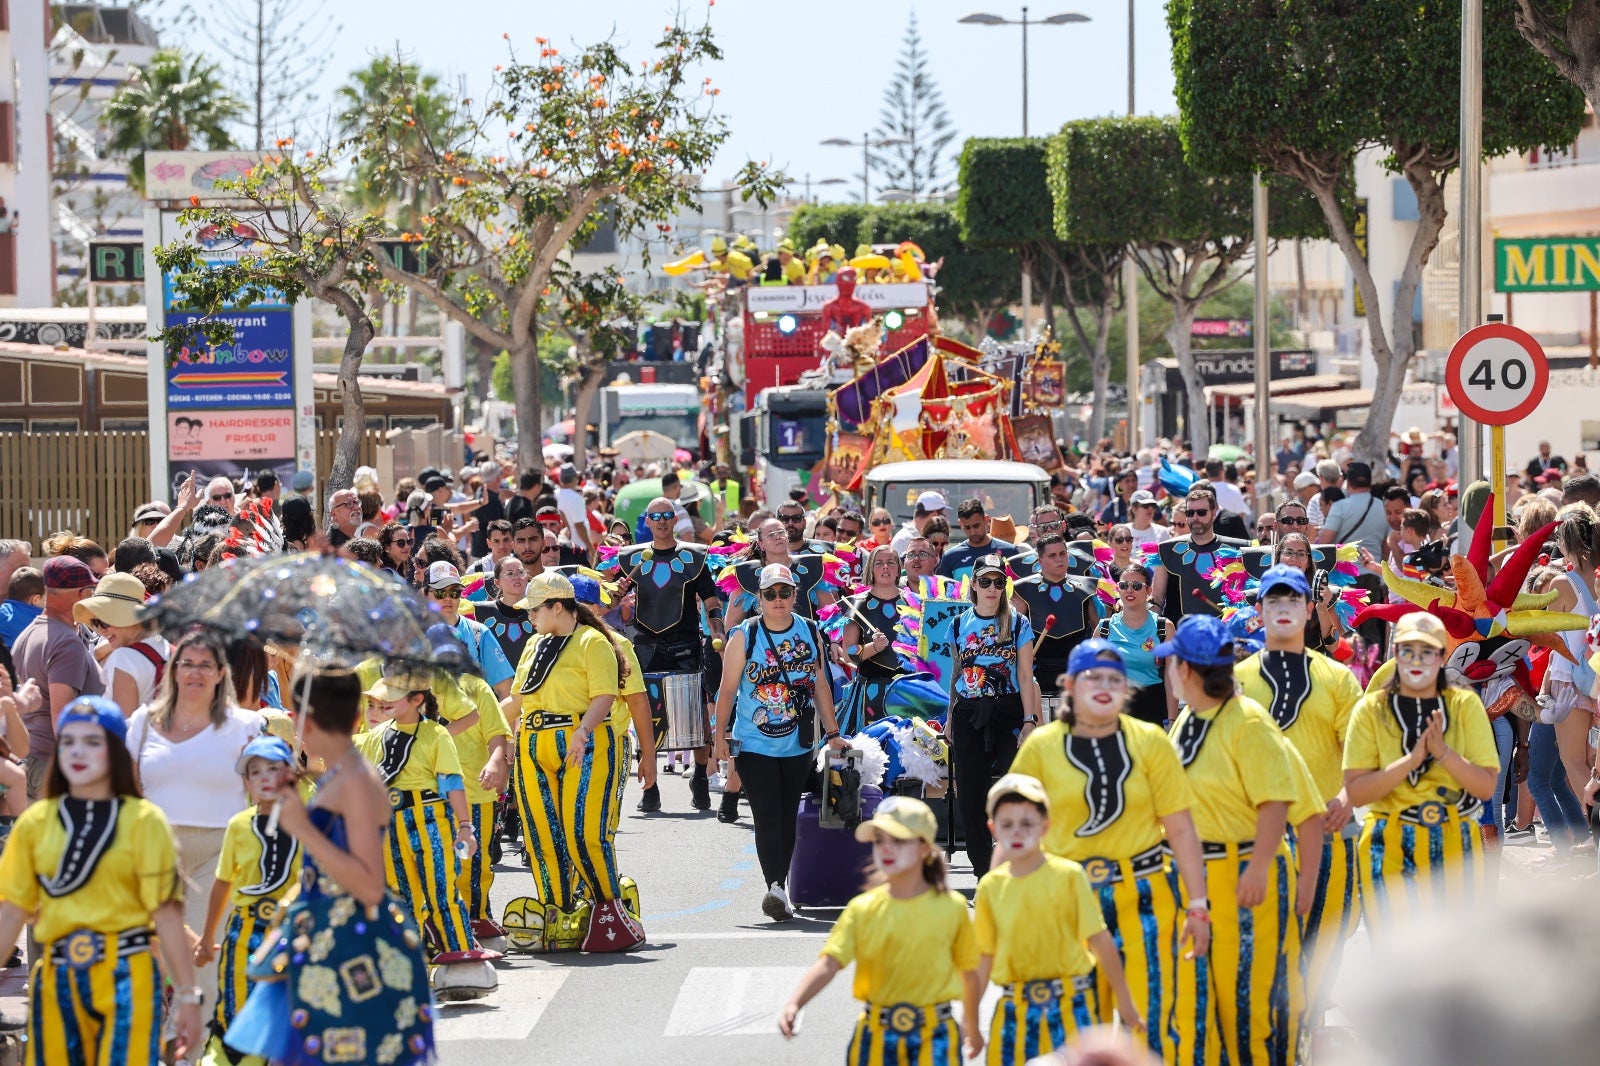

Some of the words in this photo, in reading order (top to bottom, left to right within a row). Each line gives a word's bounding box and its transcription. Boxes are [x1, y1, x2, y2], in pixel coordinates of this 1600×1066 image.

[1468, 359, 1527, 391] 40
[209, 418, 291, 429] HAIRDRESSER
[225, 434, 276, 443] FRISEUR
[784, 427, 794, 446] 1
[1421, 805, 1441, 825] G
[1086, 860, 1110, 884] G
[69, 935, 95, 964] G
[1030, 982, 1052, 1003] G
[891, 1006, 916, 1032] G
